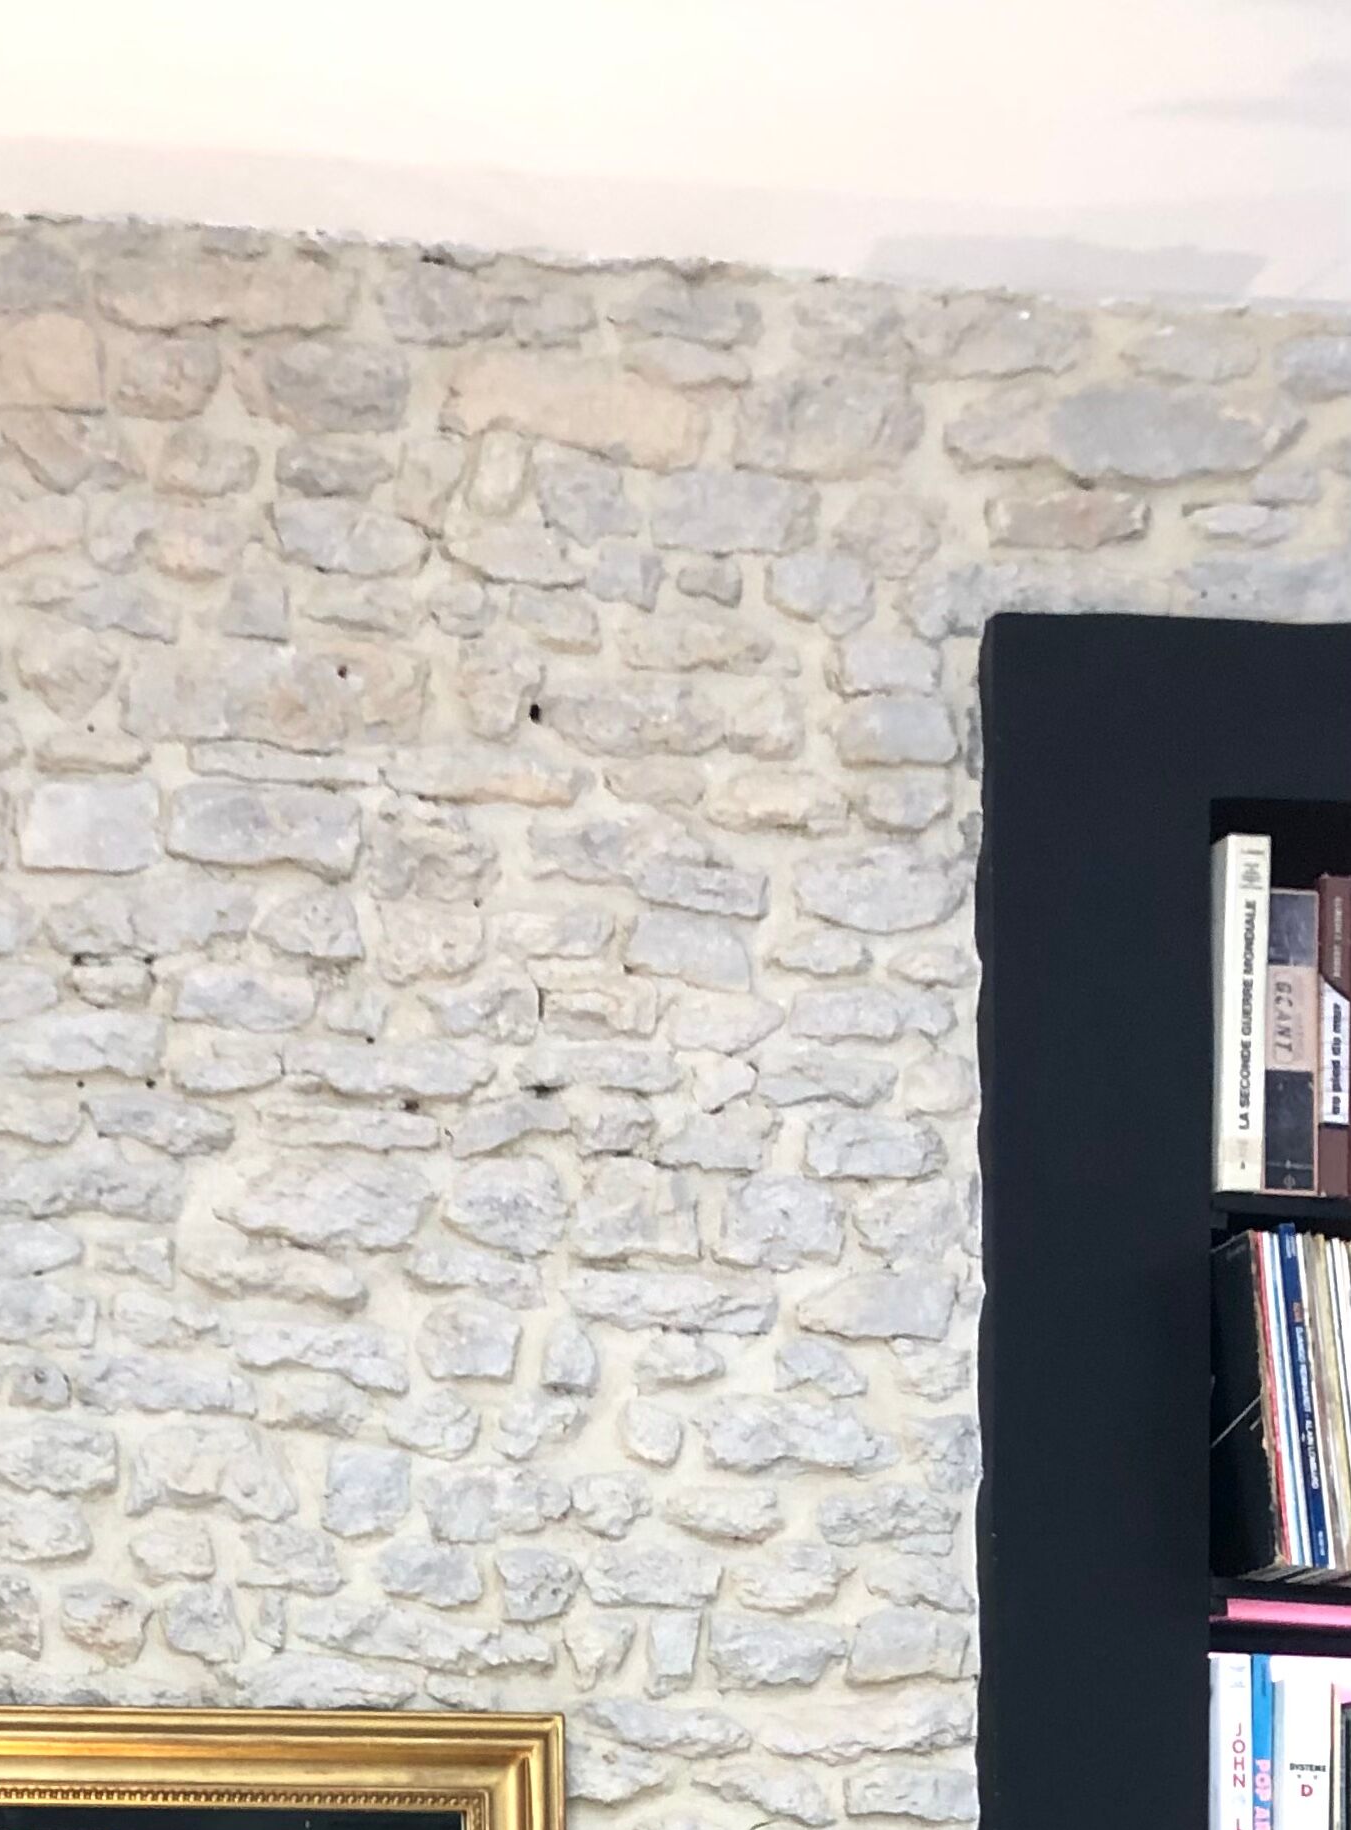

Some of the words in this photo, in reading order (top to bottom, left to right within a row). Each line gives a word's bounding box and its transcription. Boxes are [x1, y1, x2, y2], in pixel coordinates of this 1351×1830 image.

[1243, 900, 1256, 975] MONDIALE
[1241, 978, 1254, 1037] GUERRE
[1239, 1040, 1252, 1109] SECONDE
[1239, 1113, 1249, 1129] LA
[1232, 1722, 1246, 1789] JOHN
[1253, 1758, 1272, 1802] POP
[1301, 1784, 1313, 1797] D
